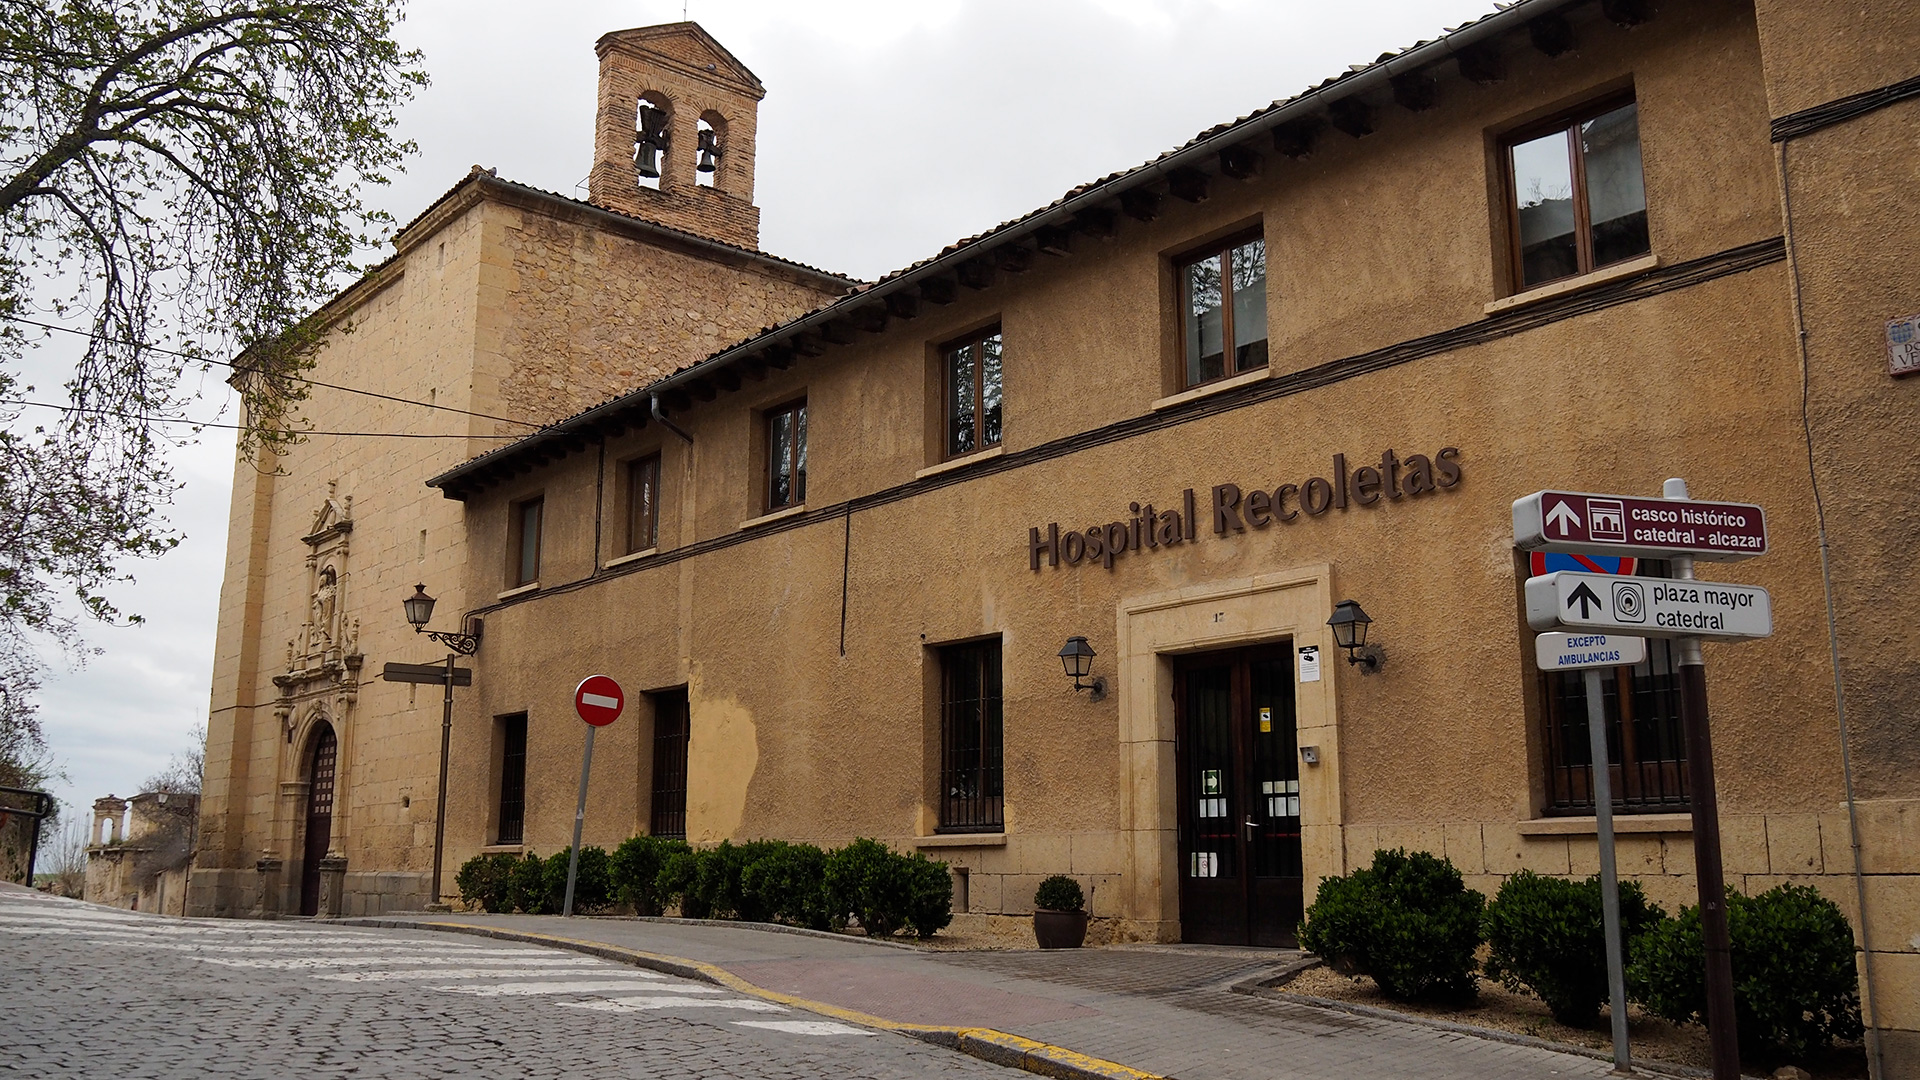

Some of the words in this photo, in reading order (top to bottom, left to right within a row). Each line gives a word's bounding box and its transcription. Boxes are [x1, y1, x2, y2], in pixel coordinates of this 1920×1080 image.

[1028, 488, 1196, 571] Hospital
[1211, 446, 1462, 534] Recoletas
[1631, 508, 1678, 523] casco
[1681, 508, 1746, 528] histórico
[1633, 527, 1696, 544] catedral
[1708, 531, 1762, 548] alcazar
[1653, 584, 1699, 605] plaza
[1704, 590, 1754, 610] mayor
[1656, 610, 1724, 630] catedral
[1567, 635, 1606, 648] EXCEPTO
[1558, 650, 1620, 666] AMBULANCIAS
